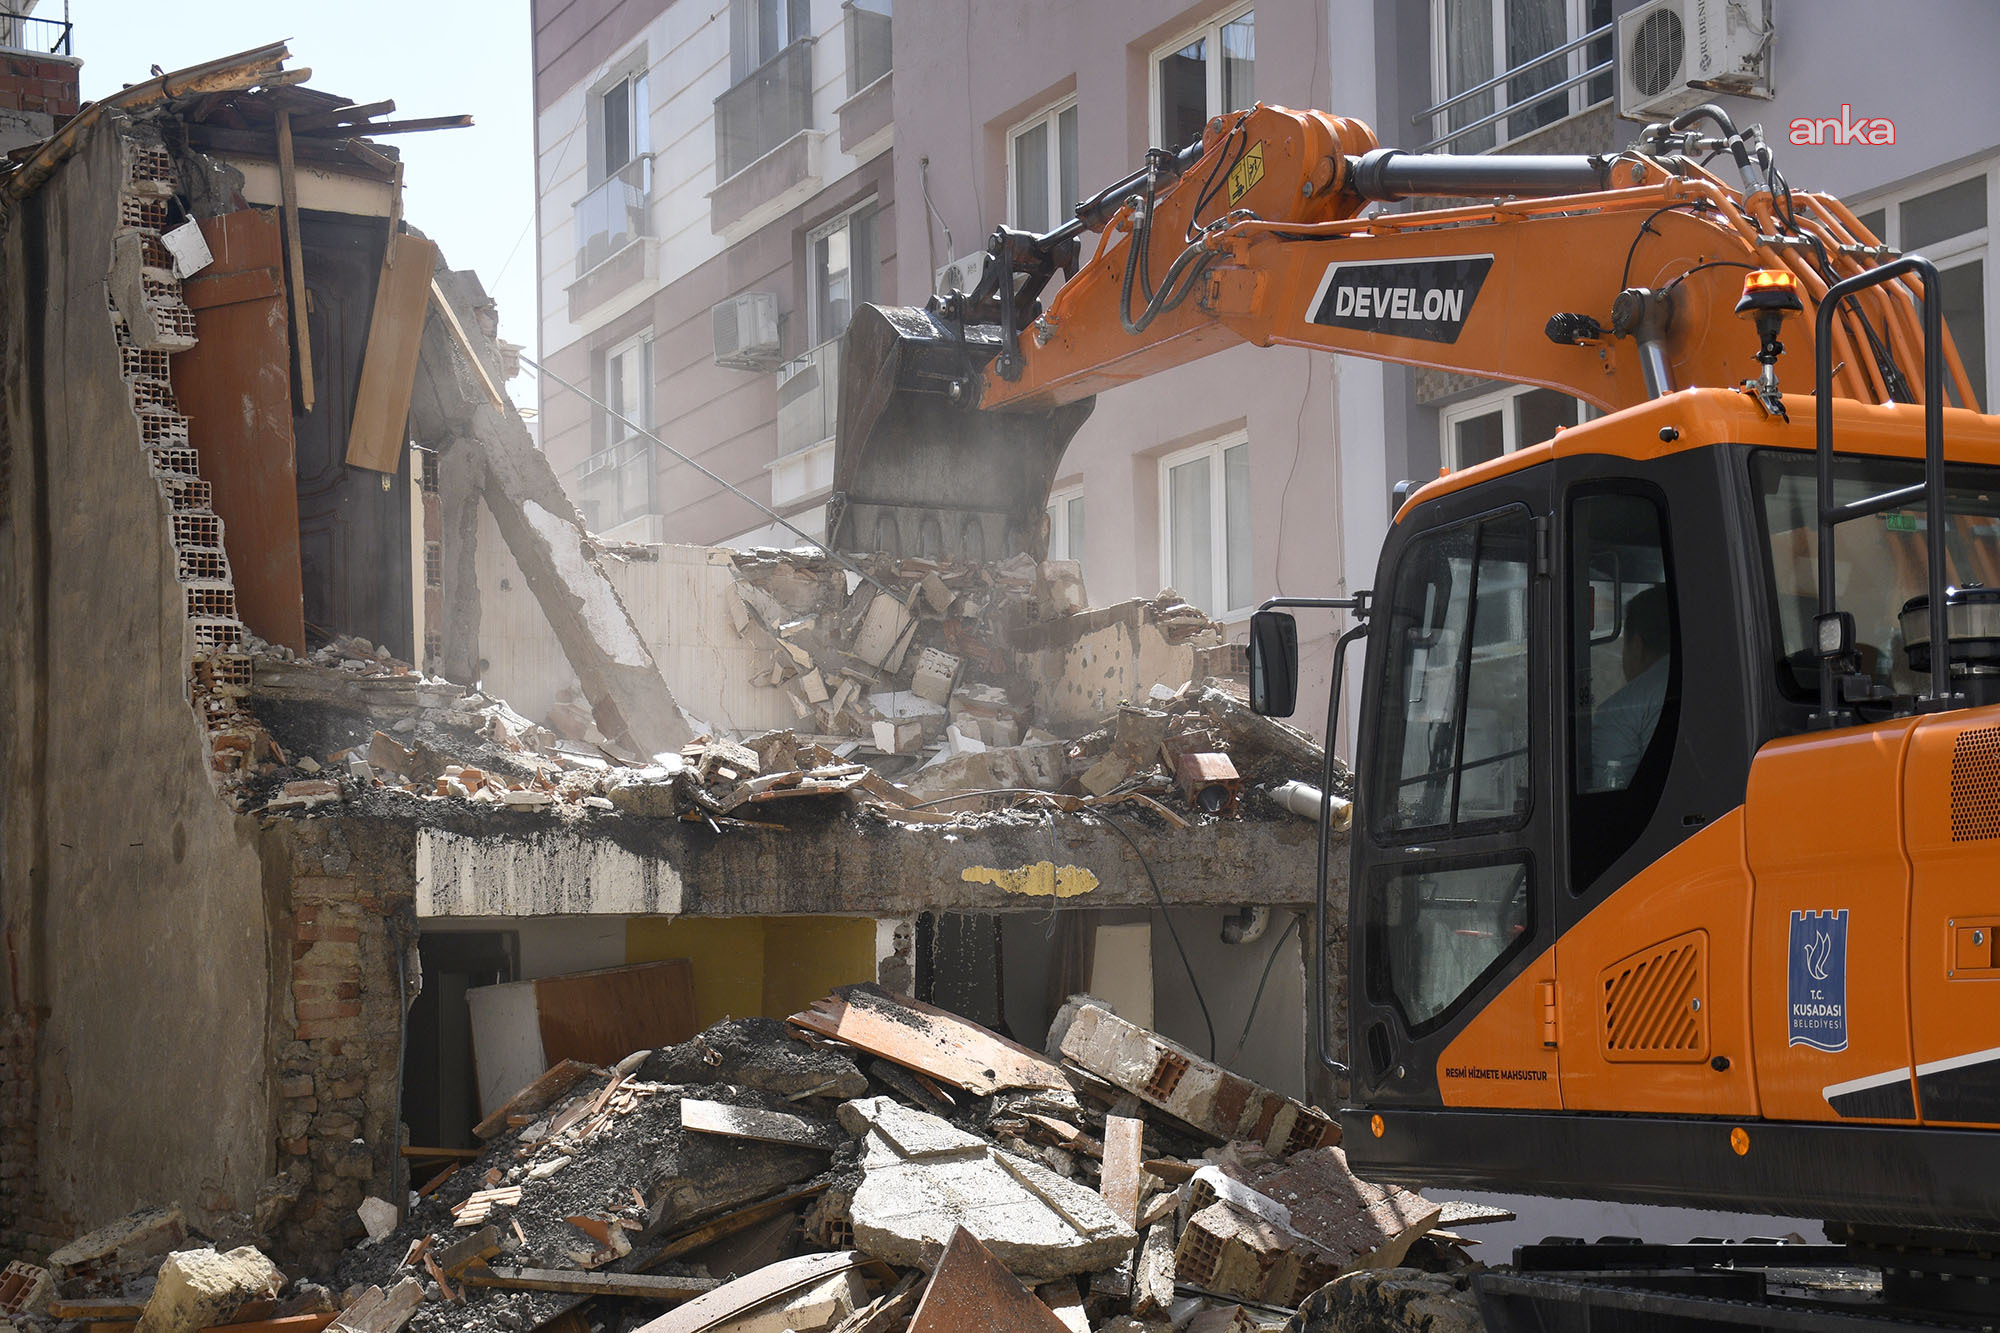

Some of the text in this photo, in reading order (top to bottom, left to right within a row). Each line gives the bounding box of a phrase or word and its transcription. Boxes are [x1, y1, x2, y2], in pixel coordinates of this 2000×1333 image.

[1335, 286, 1464, 322] DEVELON
[1810, 990, 1825, 1001] T.C.
[1793, 1003, 1842, 1017] KUŞADASI
[1793, 1018, 1842, 1030] BELEDİYESİ
[1445, 1066, 1547, 1080] RESMİ HİZMETE MAHSUSTUR
